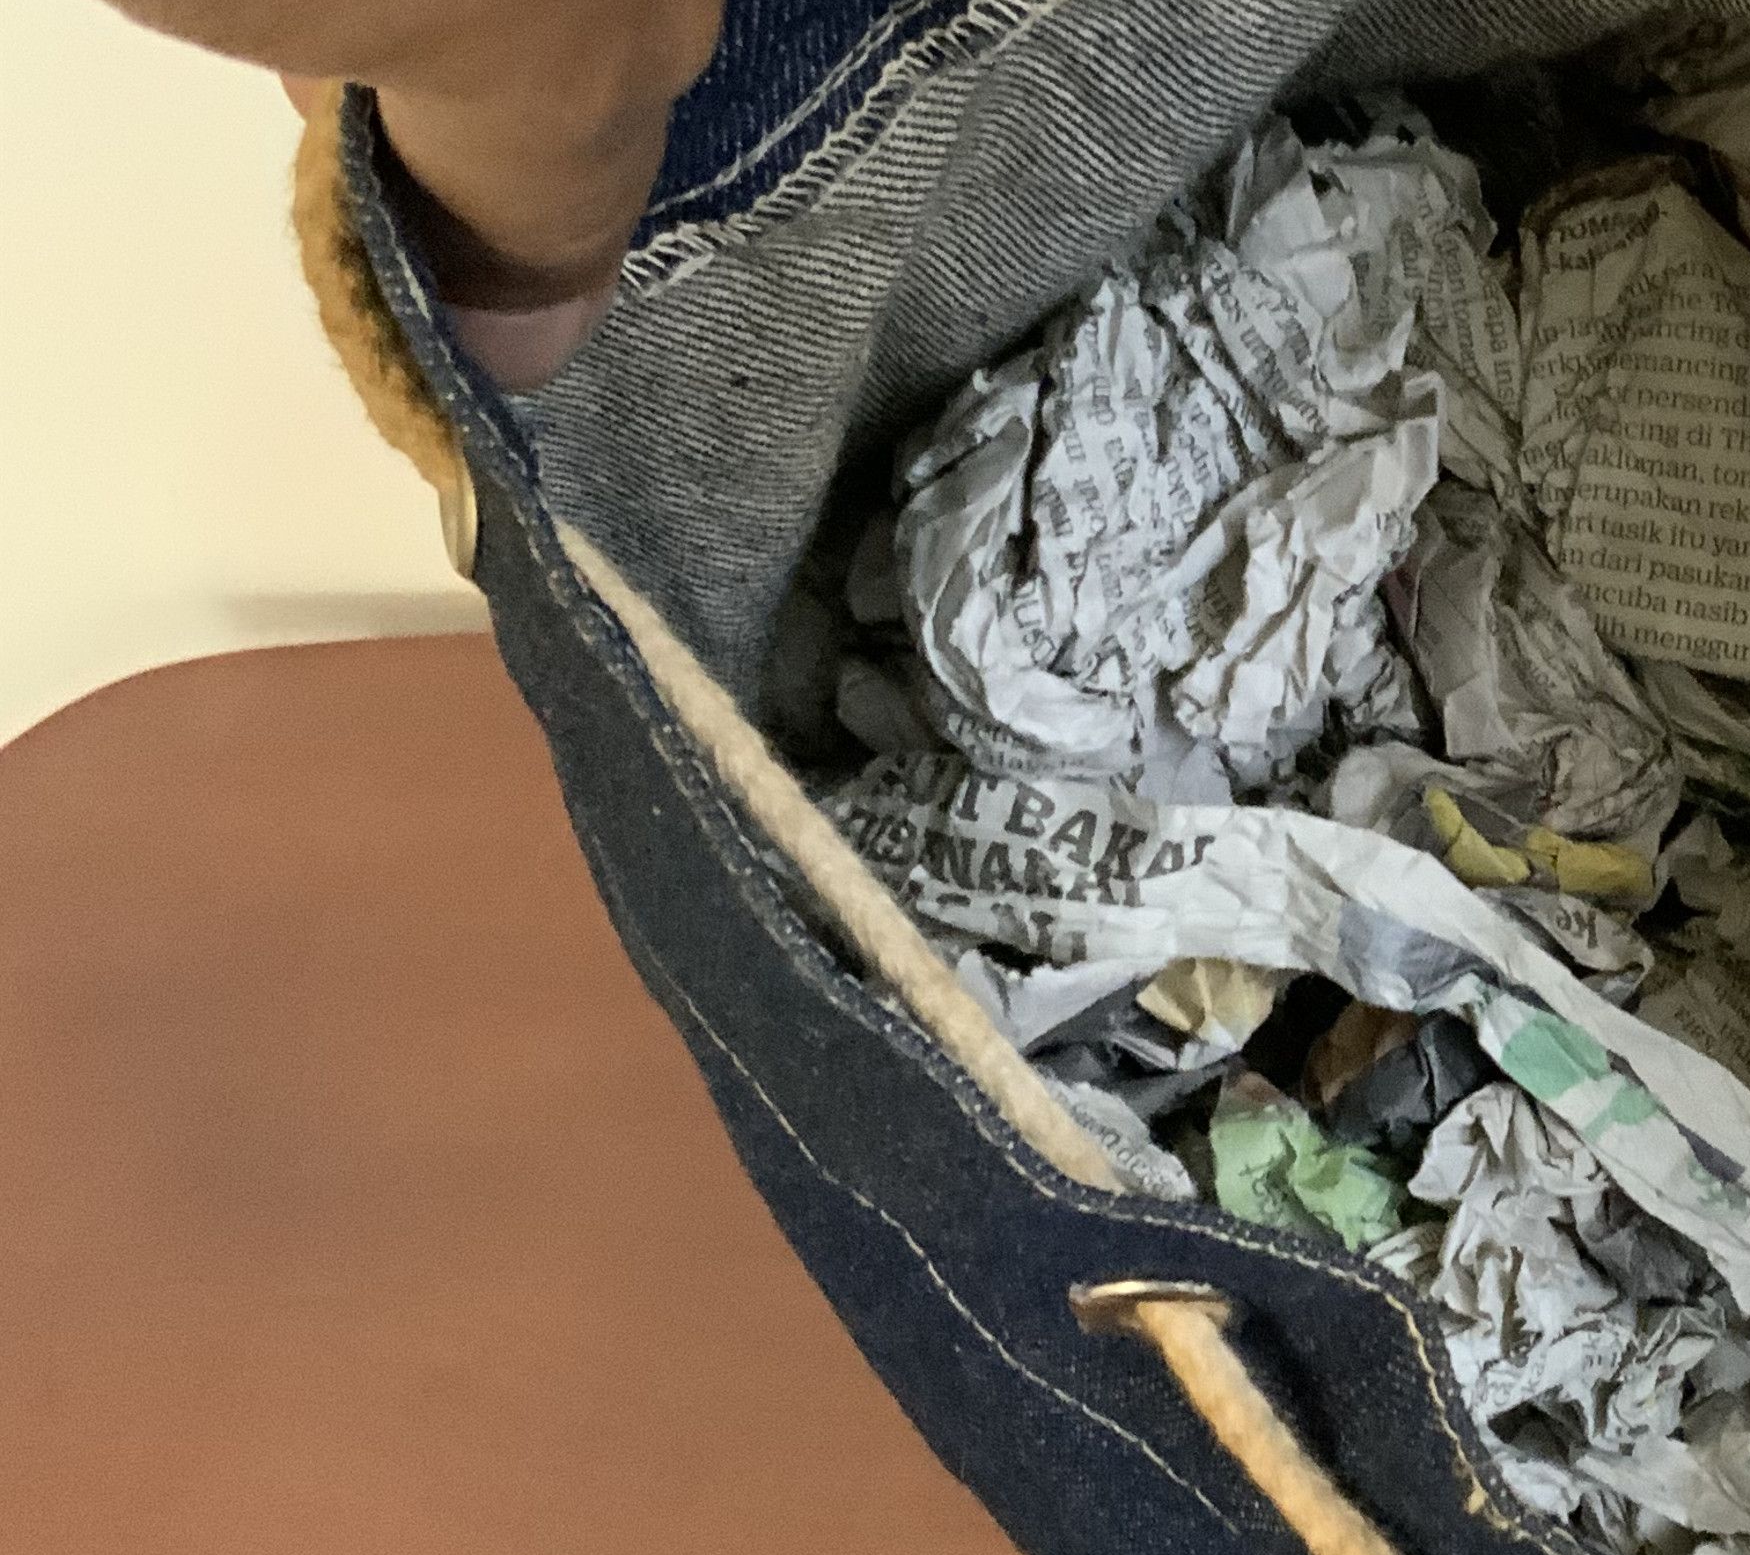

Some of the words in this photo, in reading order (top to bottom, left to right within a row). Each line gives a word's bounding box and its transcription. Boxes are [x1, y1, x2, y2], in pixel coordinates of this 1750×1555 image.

[1600, 516, 1664, 544] tasik
[1670, 524, 1706, 549] itu
[1589, 547, 1643, 574] dari
[1674, 597, 1750, 626] nasib
